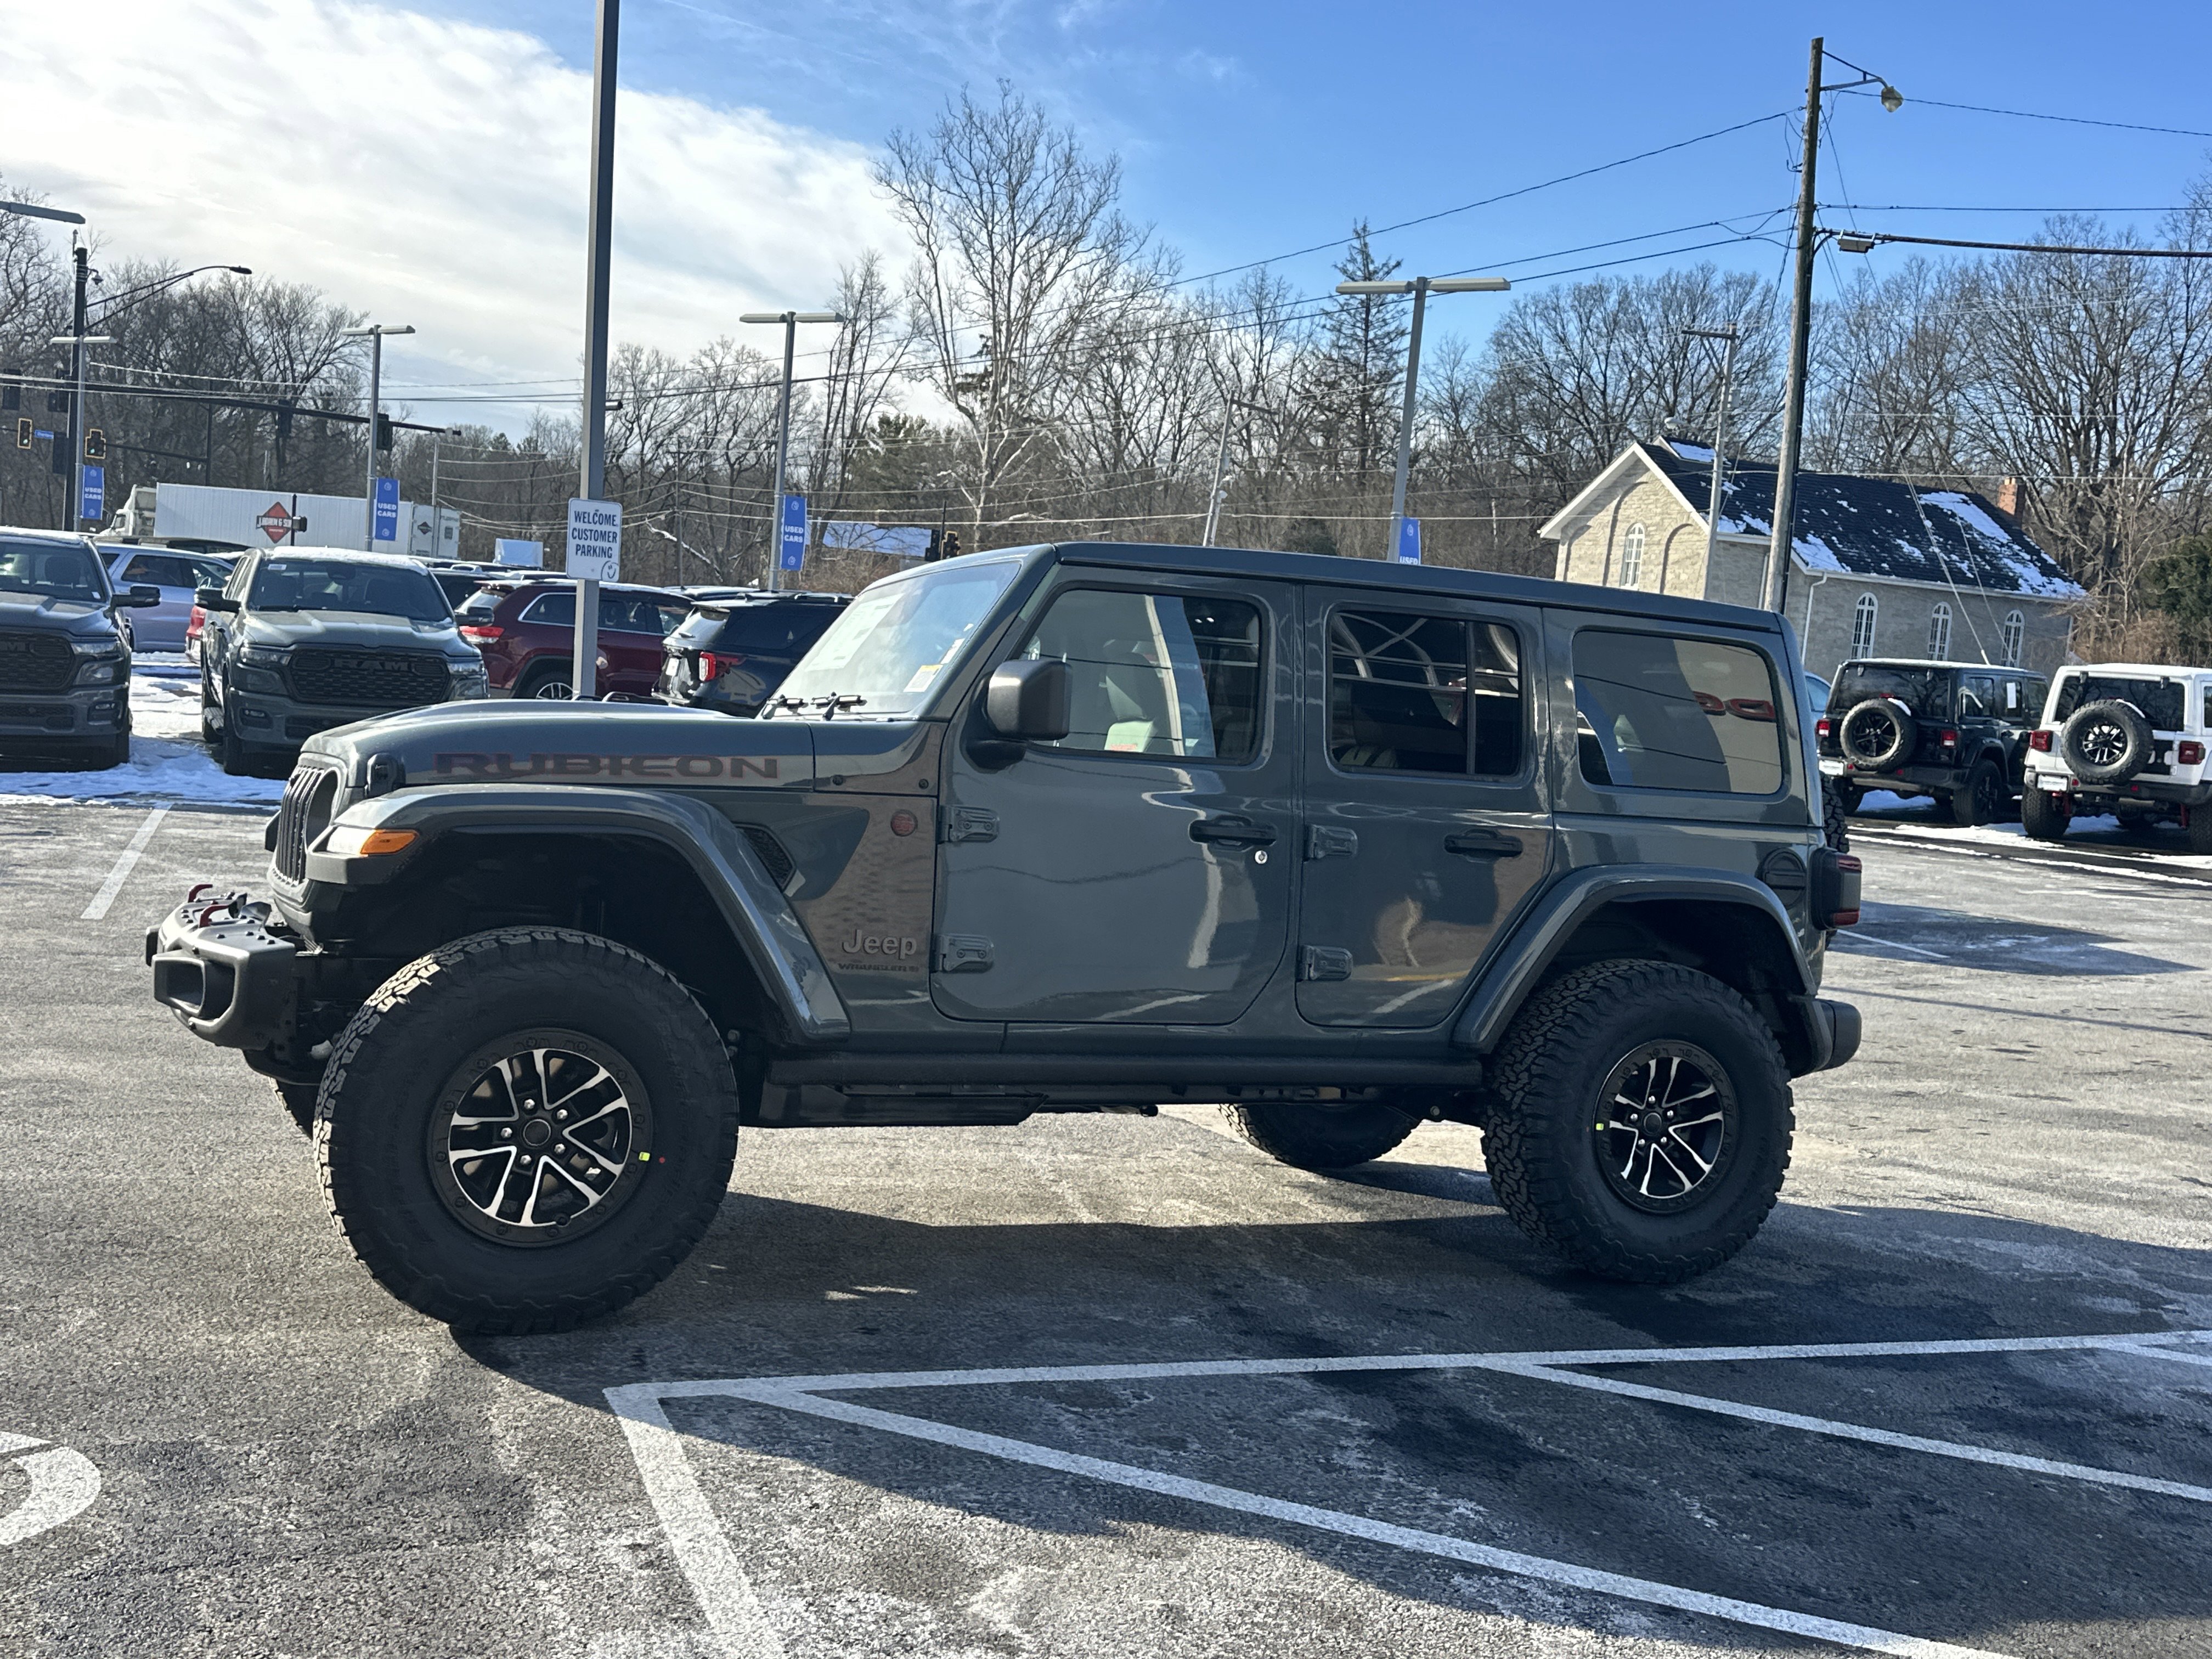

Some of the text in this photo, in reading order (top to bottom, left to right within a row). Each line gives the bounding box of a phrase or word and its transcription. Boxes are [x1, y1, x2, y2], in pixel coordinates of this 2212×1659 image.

[574, 510, 617, 527] WELCOME
[572, 527, 618, 544] CUSTOMER
[785, 525, 804, 533] USED
[784, 534, 803, 543] CARS
[575, 544, 613, 558] PARKING
[334, 659, 410, 672] RAM
[433, 752, 779, 780] RUBICON
[842, 929, 917, 960] Jeep
